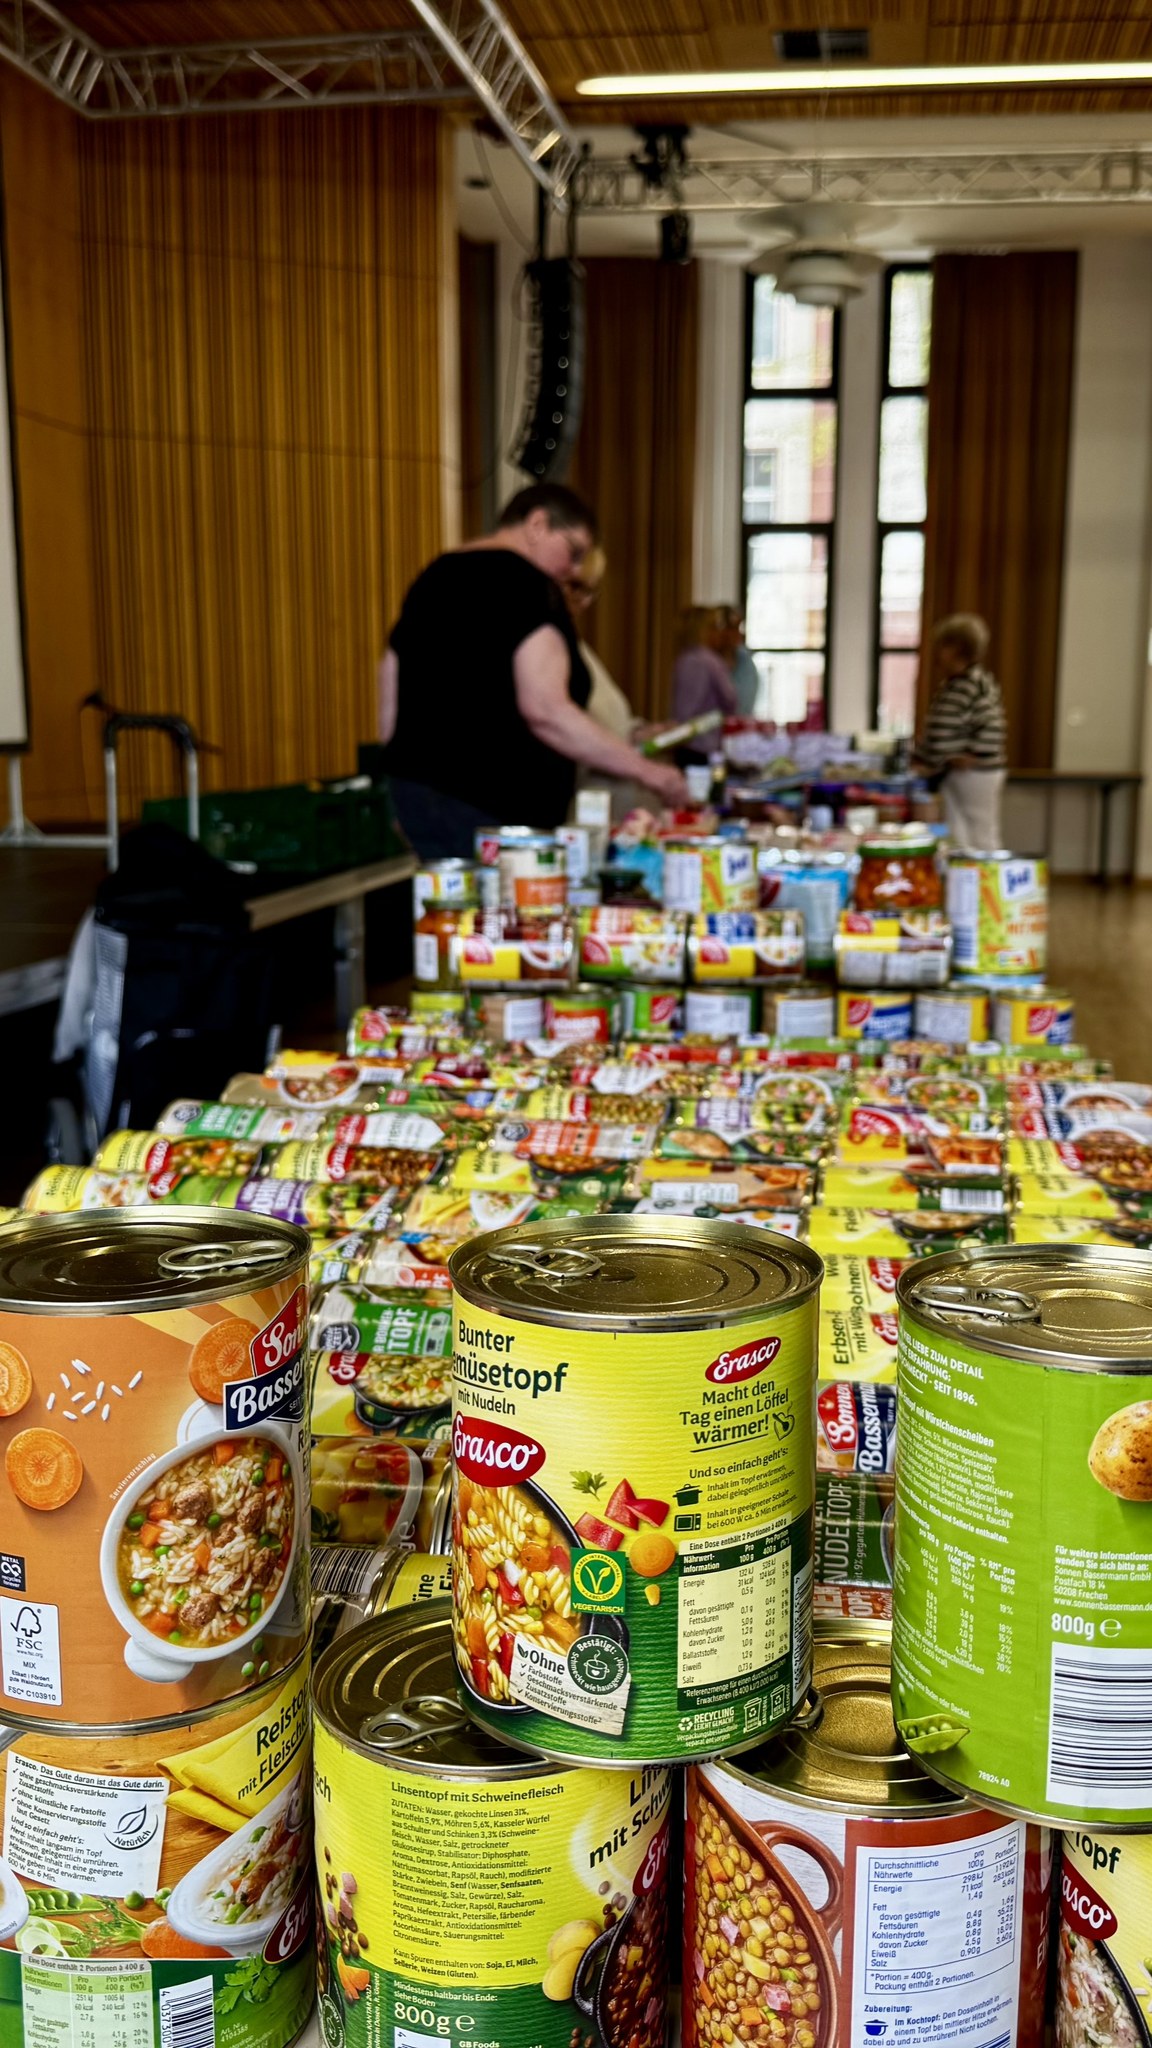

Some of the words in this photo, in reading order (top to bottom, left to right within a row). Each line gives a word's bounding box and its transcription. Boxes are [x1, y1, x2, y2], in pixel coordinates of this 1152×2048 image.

[458, 1319, 515, 1352] Bunter
[714, 1339, 778, 1381] Erasco
[912, 1338, 930, 1358] LIEBE
[930, 1349, 949, 1367] ZUM
[950, 1358, 985, 1381] DETAIL
[702, 1386, 749, 1405] Macht
[751, 1380, 775, 1397] den
[933, 1379, 952, 1396] SEIT
[953, 1388, 978, 1407] 1896.
[458, 1388, 470, 1405] mit
[472, 1392, 516, 1415] Nudeln
[679, 1410, 711, 1428] Tag
[714, 1403, 753, 1421] einen
[756, 1387, 789, 1413] Löffel
[826, 1383, 856, 1444] Sonnen
[693, 1413, 769, 1444] wärmer!
[925, 1409, 995, 1449] Würstchenscheiben
[454, 1414, 539, 1471] Erasco
[689, 1466, 711, 1479] Und
[713, 1465, 725, 1476] so
[727, 1455, 762, 1474] einfach
[823, 1481, 852, 1584] NUDELTOPF
[1055, 1544, 1068, 1556] Für
[1069, 1548, 1098, 1560] weitere
[1055, 1557, 1085, 1568] wenden
[1086, 1559, 1098, 1569] Sie
[1100, 1560, 1116, 1570] sich
[1117, 1561, 1135, 1571] bitte
[1055, 1565, 1082, 1577] Sonnen
[1083, 1569, 1128, 1580] Bassermann
[412, 1574, 435, 1601] üne
[683, 1579, 705, 1588] Energie
[1054, 1576, 1087, 1588] Postfach
[683, 1598, 695, 1607] Fett
[1078, 1589, 1108, 1600] Frechen
[572, 1602, 624, 1614] VEGETARISCH
[689, 1614, 719, 1625] Fettsäuren
[1051, 1612, 1096, 1642] 800g
[683, 1625, 724, 1639] Kohlenhydrate
[707, 1633, 725, 1645] Zucker
[16, 1637, 43, 1651] FSC
[577, 1638, 617, 1656] Bestätigt:
[683, 1647, 718, 1661] Ballaststoffe
[23, 1661, 37, 1669] MIX
[529, 1650, 566, 1675] Ohne
[528, 1665, 563, 1686] Farbstoffe
[526, 1683, 567, 1706] Zusatzstoffe
[527, 1674, 619, 1712] Geschmacksverstärkende
[584, 1683, 597, 1693] wie
[26, 1691, 57, 1702] C103910
[694, 1706, 735, 1723] RECYCLING
[14, 1755, 39, 1772] Erasco.
[40, 1765, 54, 1777] Das
[55, 1770, 72, 1781] Gute
[73, 1773, 95, 1785] daran
[96, 1776, 106, 1786] ist
[107, 1778, 121, 1788] das
[122, 1779, 141, 1789] Gute
[142, 1777, 165, 1789] darin.
[18, 1779, 55, 1797] Zusatzstoffe
[19, 1770, 34, 1783] ohne
[34, 1776, 119, 1799] geschmacksverstärkende
[238, 1777, 257, 1800] mit
[391, 1781, 450, 1803] Linsentopf
[451, 1792, 470, 1802] mit
[471, 1784, 565, 1803] Schweinefleisch
[17, 1789, 33, 1802] ohne
[34, 1794, 69, 1811] künstliche
[70, 1803, 107, 1818] Farbstoffe
[391, 1798, 425, 1814] ZUTATEN:
[425, 1806, 454, 1818] Wasser,
[454, 1809, 488, 1819] gekochte
[489, 1810, 514, 1819] Linsen
[16, 1800, 32, 1812] ohne
[33, 1803, 107, 1828] Konservierungsstoffe
[444, 1818, 472, 1828] Möhren
[473, 1820, 493, 1830] 5,6%,
[494, 1817, 526, 1829] Kasseler
[526, 1814, 551, 1826] Würfel
[11, 1815, 24, 1828] Und
[24, 1822, 32, 1832] so
[32, 1825, 59, 1841] einfach
[447, 1829, 480, 1839] Schinken
[481, 1830, 498, 1840] 3,3%
[114, 1829, 152, 1850] Natürlich
[461, 1841, 510, 1851] getrockneter
[589, 1827, 628, 1868] mit
[438, 1849, 481, 1860] Stabilisator:
[482, 1850, 531, 1861] Diphosphate,
[508, 1866, 553, 1878] modifizierte
[874, 1859, 940, 1871] Durchschnittliche
[874, 1870, 913, 1881] Nährwerte
[451, 1881, 468, 1890] Senf
[500, 1878, 545, 1890] Senfsaaten,
[873, 1884, 903, 1895] Energie
[872, 1903, 887, 1912] Fett
[1062, 1871, 1112, 1929] asco
[879, 1910, 903, 1921] davon
[904, 1909, 941, 1922] gesättigte
[879, 1921, 919, 1931] Fettsäuren
[871, 1930, 925, 1942] Kohlenhydrate
[878, 1940, 902, 1950] davon
[903, 1938, 929, 1949] Zucker
[871, 1949, 897, 1958] Eiweiß
[870, 1957, 887, 1968] Salz
[874, 1981, 907, 1991] Packung
[908, 1978, 934, 1990] enthält
[863, 2005, 913, 2014] Zubereitung:
[394, 2001, 451, 2036] 800g
[907, 2013, 942, 2026] Kochtopf:
